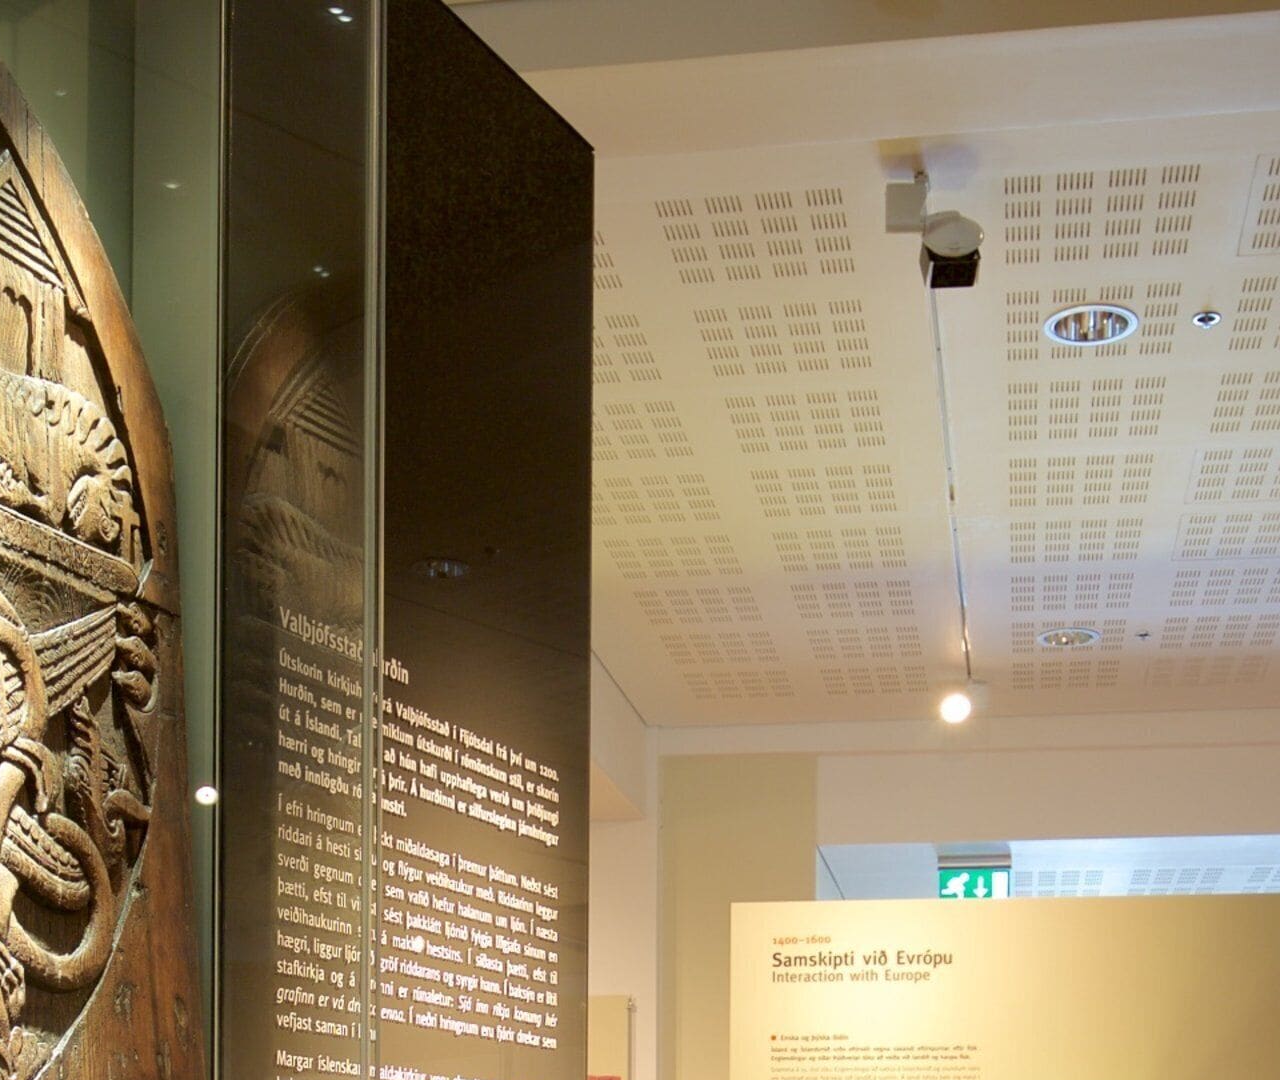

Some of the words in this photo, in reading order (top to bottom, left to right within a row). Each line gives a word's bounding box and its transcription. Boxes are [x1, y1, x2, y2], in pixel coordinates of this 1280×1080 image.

[279, 648, 323, 681] Útskorin
[279, 677, 317, 707] Hurðin,
[321, 697, 342, 715] sem
[306, 710, 342, 741] Íslandi.
[278, 730, 307, 754] hærri
[278, 761, 301, 779] með
[305, 766, 349, 794] innlögðu
[286, 800, 303, 818] efri
[307, 805, 354, 833] hringnum
[278, 824, 312, 847] riddari
[326, 837, 350, 858] hesti
[278, 853, 309, 872] sverði
[314, 864, 354, 884] gegnum
[385, 885, 404, 900] sem
[278, 876, 309, 901] þætti,
[313, 887, 332, 905] efst
[277, 906, 352, 934] veiðihaukurinn
[277, 930, 310, 954] hægri,
[313, 938, 343, 960] liggur
[772, 951, 855, 970] Samskipti
[862, 950, 888, 966] við
[896, 949, 953, 968] Evrópu
[277, 960, 325, 983] stafkirkja
[772, 970, 844, 983] Interaction
[850, 969, 879, 983] with
[884, 969, 931, 984] Europe
[276, 1012, 312, 1032] vefjast
[315, 1020, 348, 1036] saman
[277, 1050, 313, 1072] Margar
